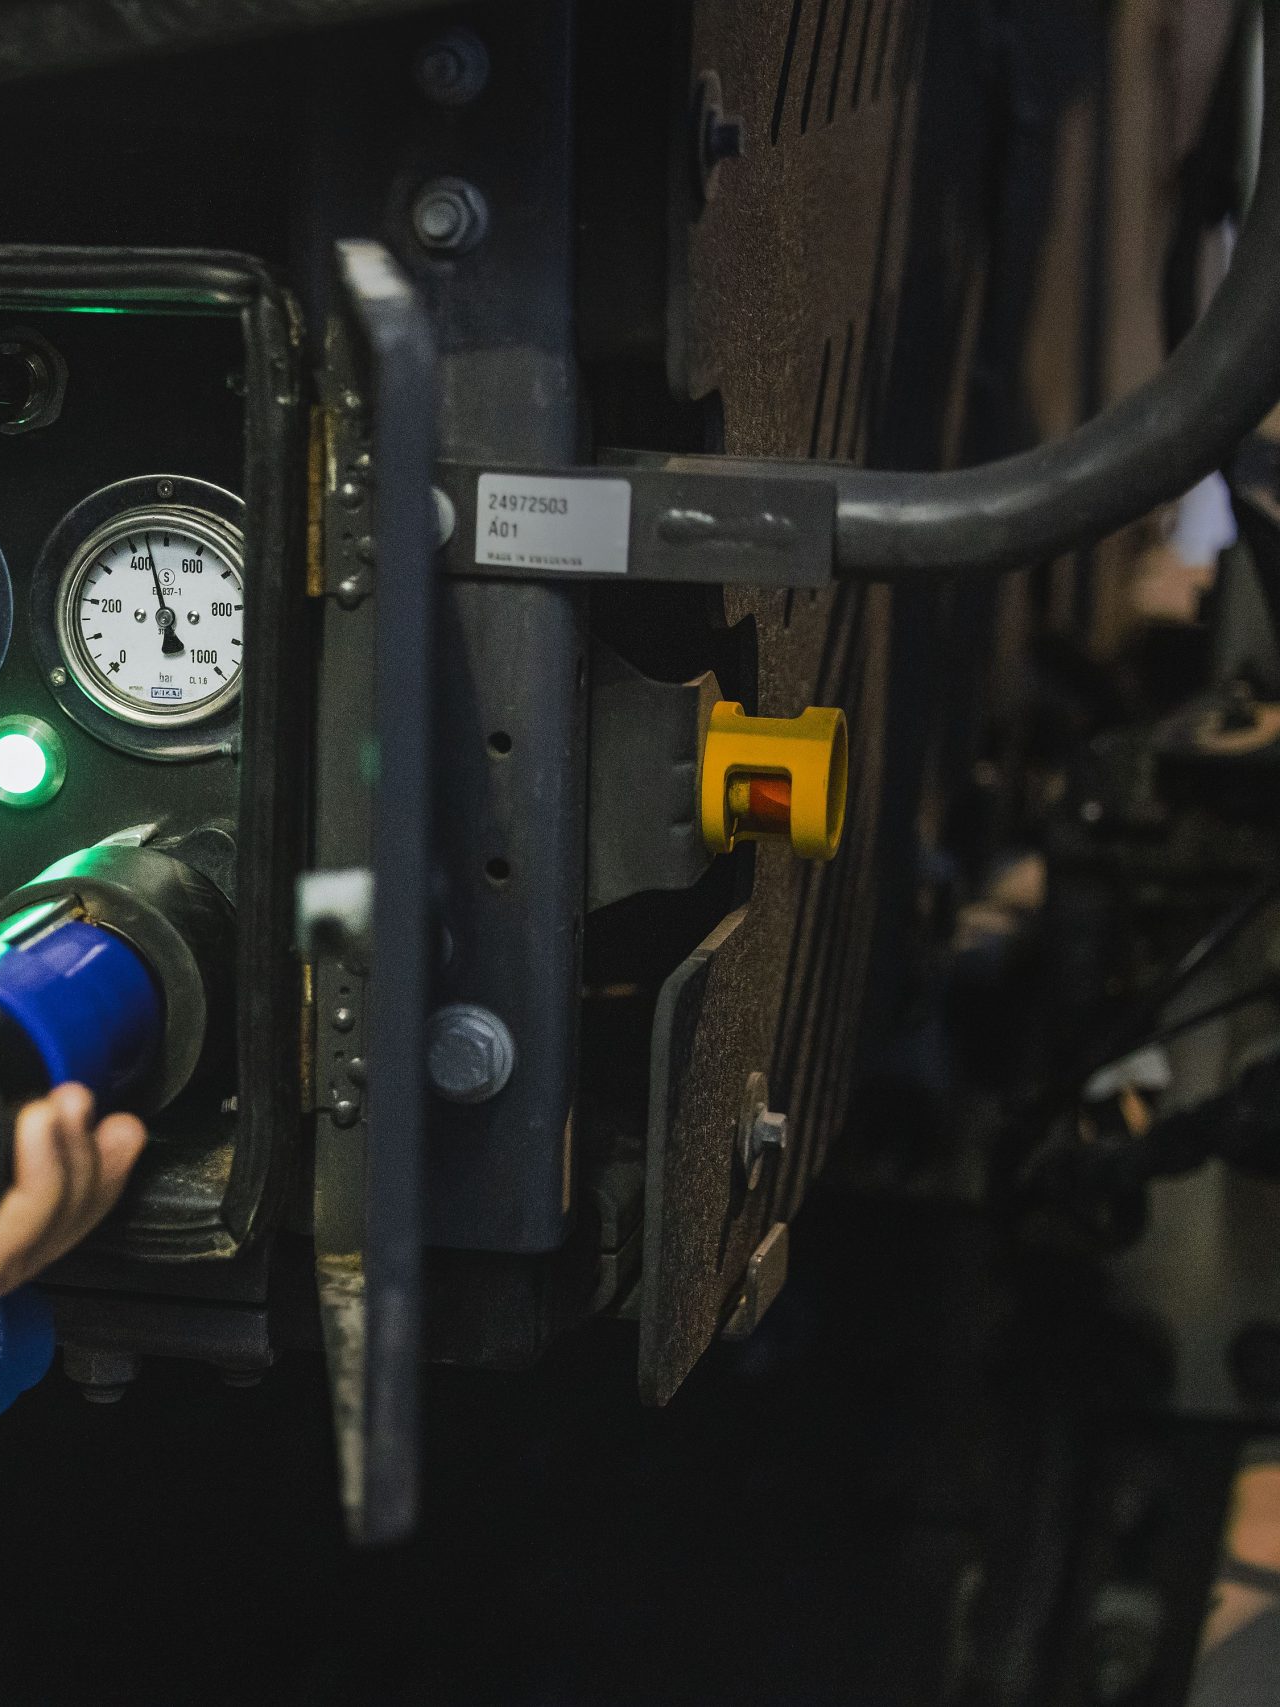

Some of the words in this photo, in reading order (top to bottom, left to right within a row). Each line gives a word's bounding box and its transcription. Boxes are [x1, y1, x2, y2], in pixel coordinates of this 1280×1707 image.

[488, 494, 568, 515] 24972503
[130, 556, 152, 571] 400
[181, 558, 203, 574] 600
[101, 599, 122, 613] 200
[211, 602, 233, 617] 800
[119, 649, 126, 664] 0
[190, 649, 218, 664] 1000
[159, 672, 173, 683] bar
